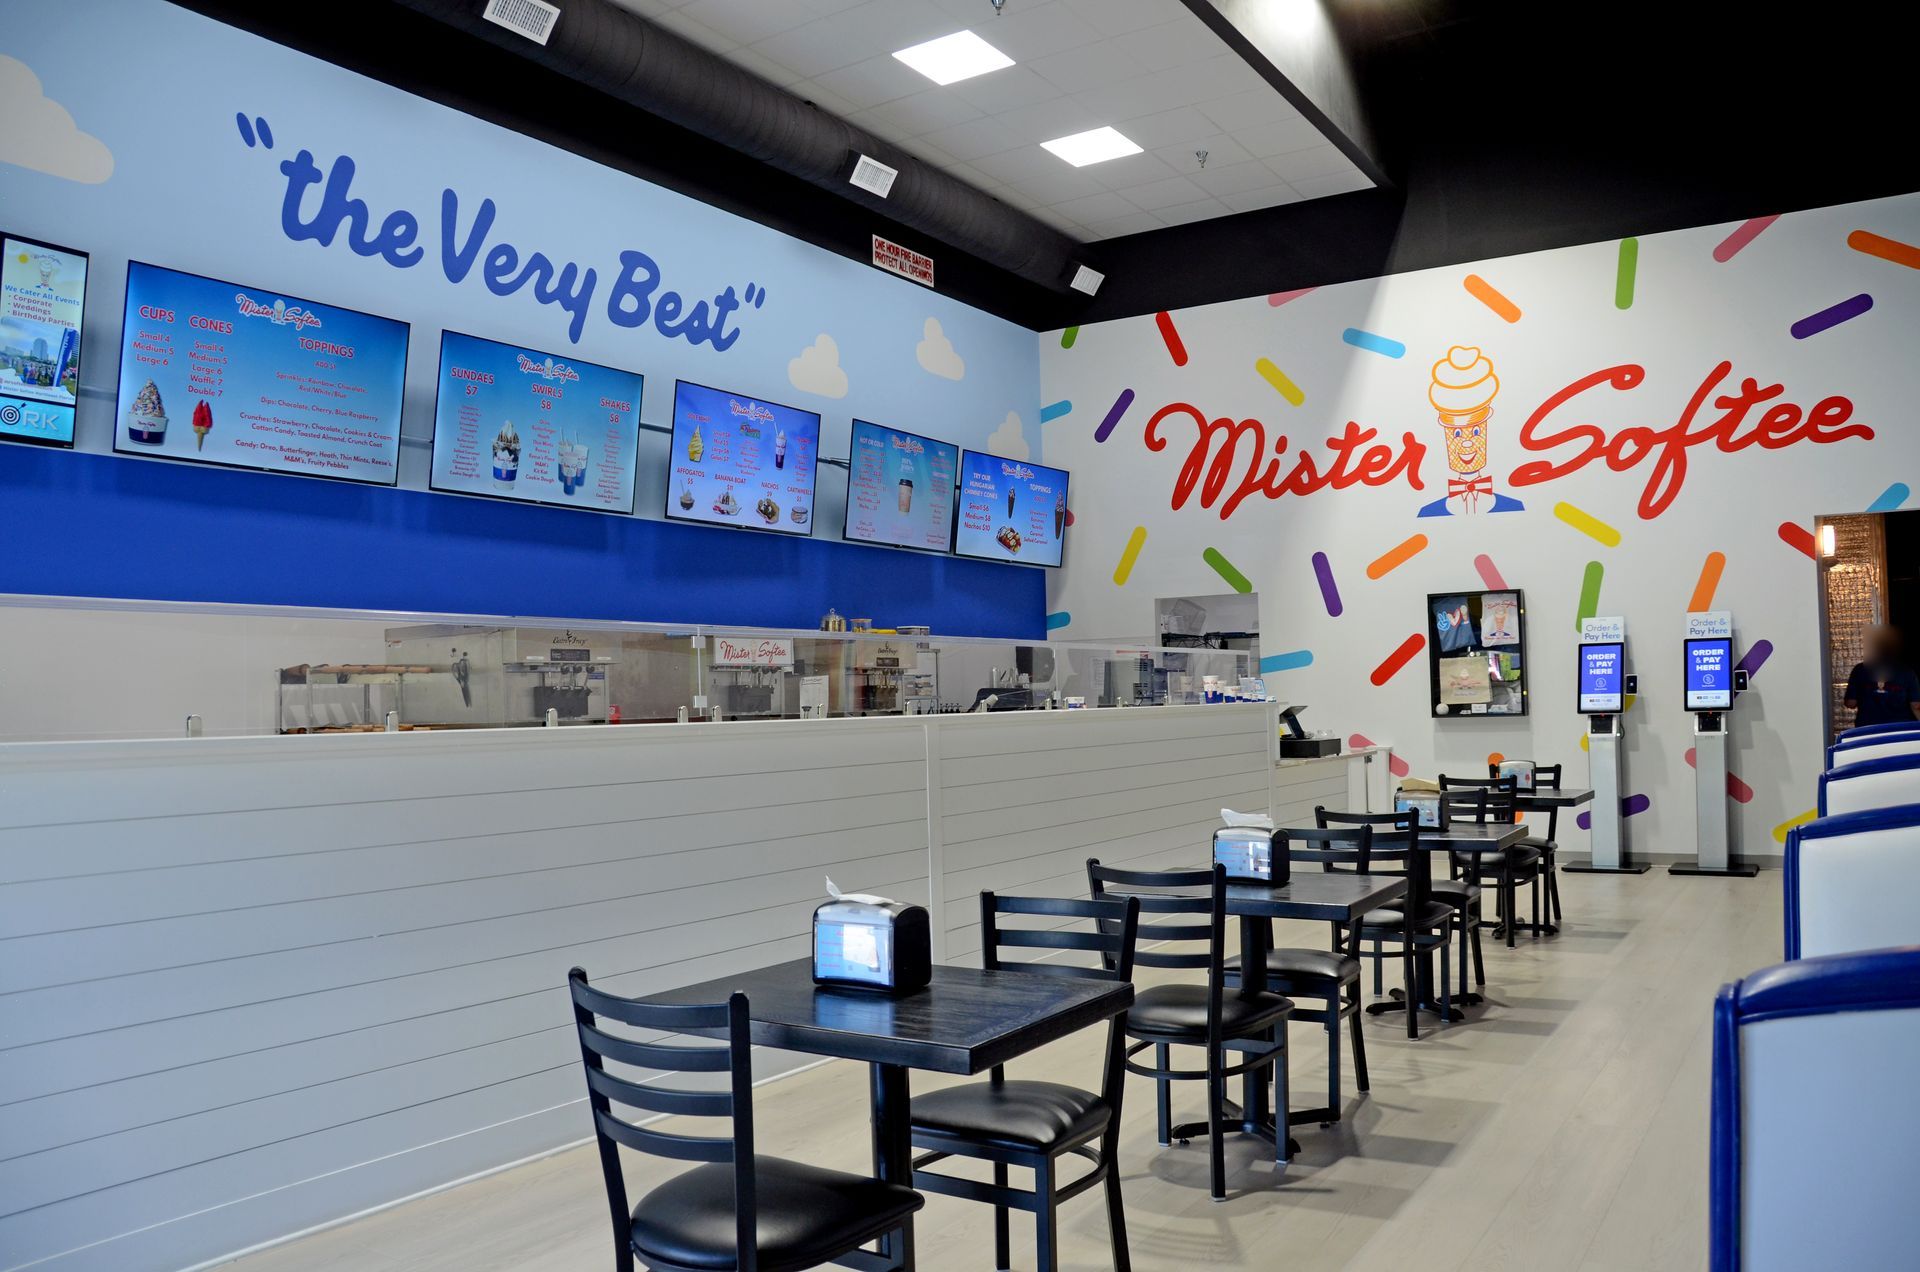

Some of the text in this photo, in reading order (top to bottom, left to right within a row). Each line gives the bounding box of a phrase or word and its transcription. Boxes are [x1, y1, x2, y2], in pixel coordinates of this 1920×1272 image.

[875, 238, 932, 271] ONE HOUR FIRE BARRIER
[441, 188, 597, 344] Very
[875, 250, 932, 283] PROTECT ALL OPENINGS
[5, 284, 17, 292] We
[20, 288, 41, 297] Cater
[55, 296, 80, 306] Events
[13, 294, 53, 308] Corporate
[13, 302, 51, 315] Weddings
[235, 293, 321, 331] Mister Softee
[12, 310, 75, 327] Birthday Parties
[139, 305, 233, 334] CUPS CONES
[139, 331, 163, 342] Small
[133, 342, 174, 355] Medium 5
[195, 341, 217, 352] Small
[299, 337, 354, 358] TOPPINGS
[136, 354, 161, 365] Large
[189, 352, 227, 365] Medium 5
[192, 364, 215, 375] Large
[517, 353, 580, 384] Mister Softee
[190, 374, 215, 385] Waffle
[451, 367, 495, 385] SUNDAES
[188, 385, 216, 396] Double
[465, 385, 478, 396] $7
[532, 383, 563, 398] SWIRLS
[541, 400, 552, 410] $8
[600, 398, 631, 411] SHAKES
[348, 411, 378, 422] Raspberry
[609, 413, 620, 423] $8
[252, 423, 273, 431] Cotton
[297, 430, 320, 438] Toasted
[348, 438, 368, 446] Crunch
[344, 428, 366, 437] Cookies
[1145, 360, 1875, 520] Mister Softee
[307, 458, 325, 467] Fruity
[327, 461, 349, 469] Pebbles
[677, 467, 705, 478] AFFOGATOS
[715, 473, 734, 482] BANANA
[973, 472, 981, 480] TRY
[761, 481, 779, 490] NACHOS
[1029, 483, 1052, 494] TOPPINGS
[968, 502, 982, 511] Small
[965, 511, 984, 520] Medium
[964, 521, 981, 531] Nachos
[1691, 618, 1716, 626] Order
[1586, 624, 1610, 632] Order
[1689, 627, 1728, 636] Pay Here
[1585, 632, 1620, 642] Pay Here
[720, 640, 786, 663] Mister Softee
[1692, 648, 1724, 656] ORDER
